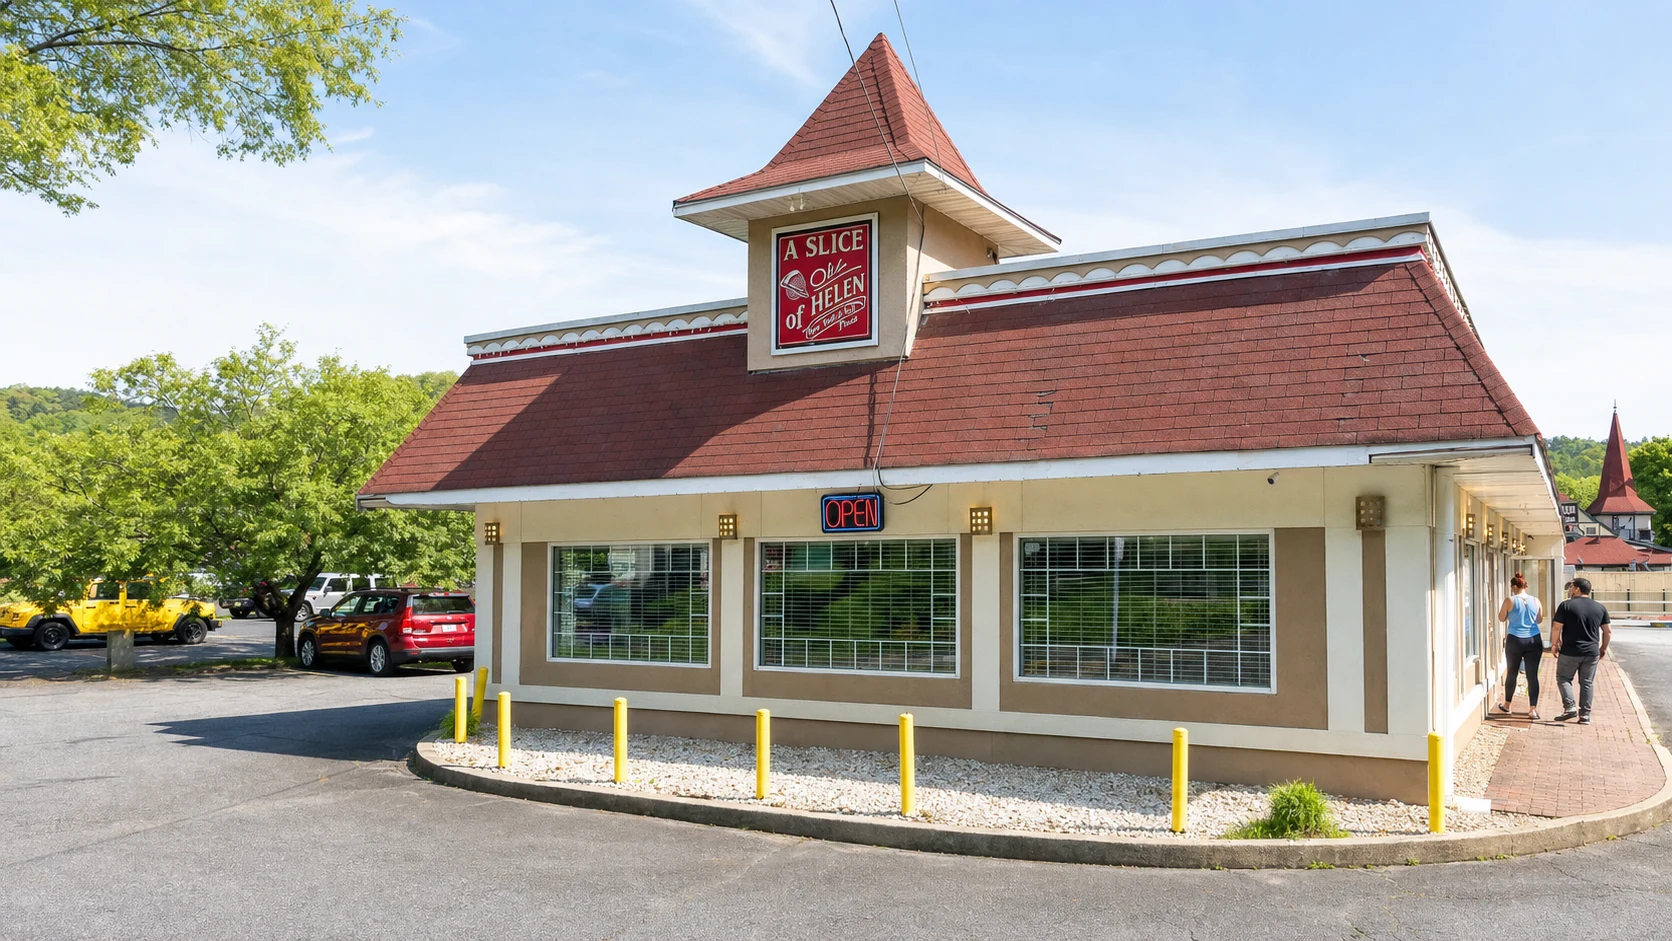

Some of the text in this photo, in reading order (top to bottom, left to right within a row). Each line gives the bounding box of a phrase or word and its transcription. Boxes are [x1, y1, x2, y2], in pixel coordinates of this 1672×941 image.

[784, 229, 864, 261] A SLICE
[786, 304, 805, 330] of
[811, 273, 865, 316] HELEN
[825, 499, 877, 528] OPEN
